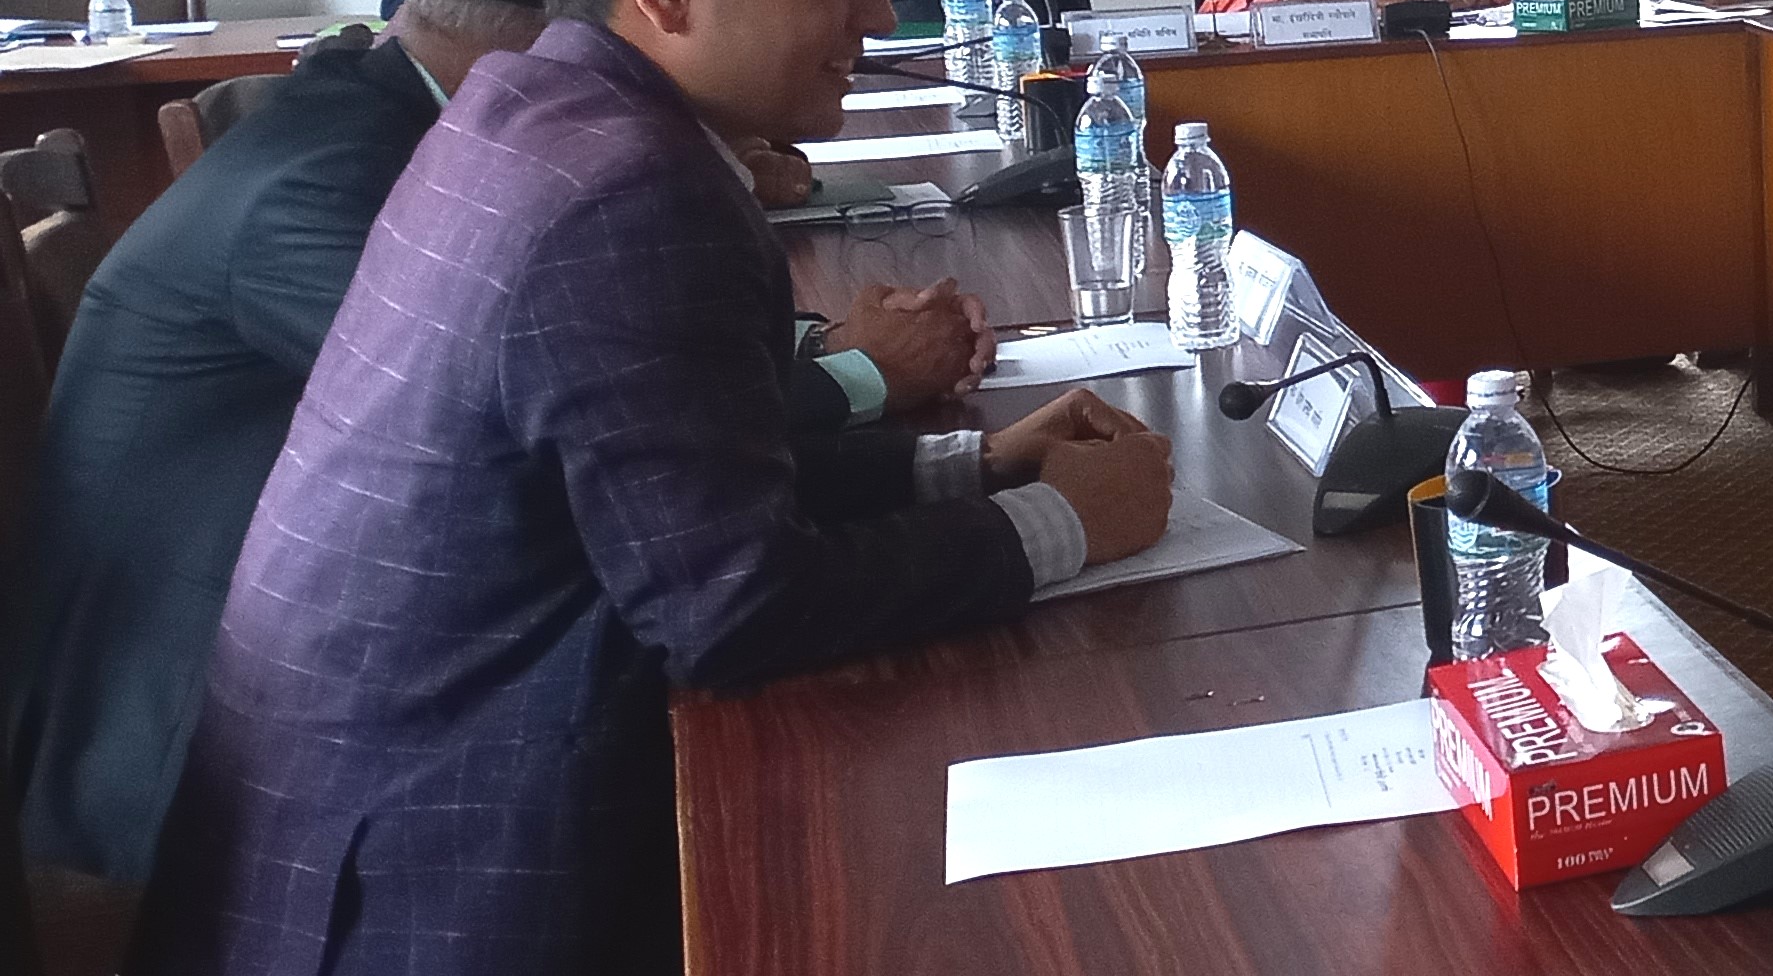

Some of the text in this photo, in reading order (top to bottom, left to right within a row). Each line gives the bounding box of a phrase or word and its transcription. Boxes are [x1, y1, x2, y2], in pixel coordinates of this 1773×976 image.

[1516, 2, 1562, 16] PREMIUM
[1467, 669, 1577, 766] PREMIUM
[1528, 763, 1709, 831] PREMIUM
[1556, 853, 1587, 870] 100
